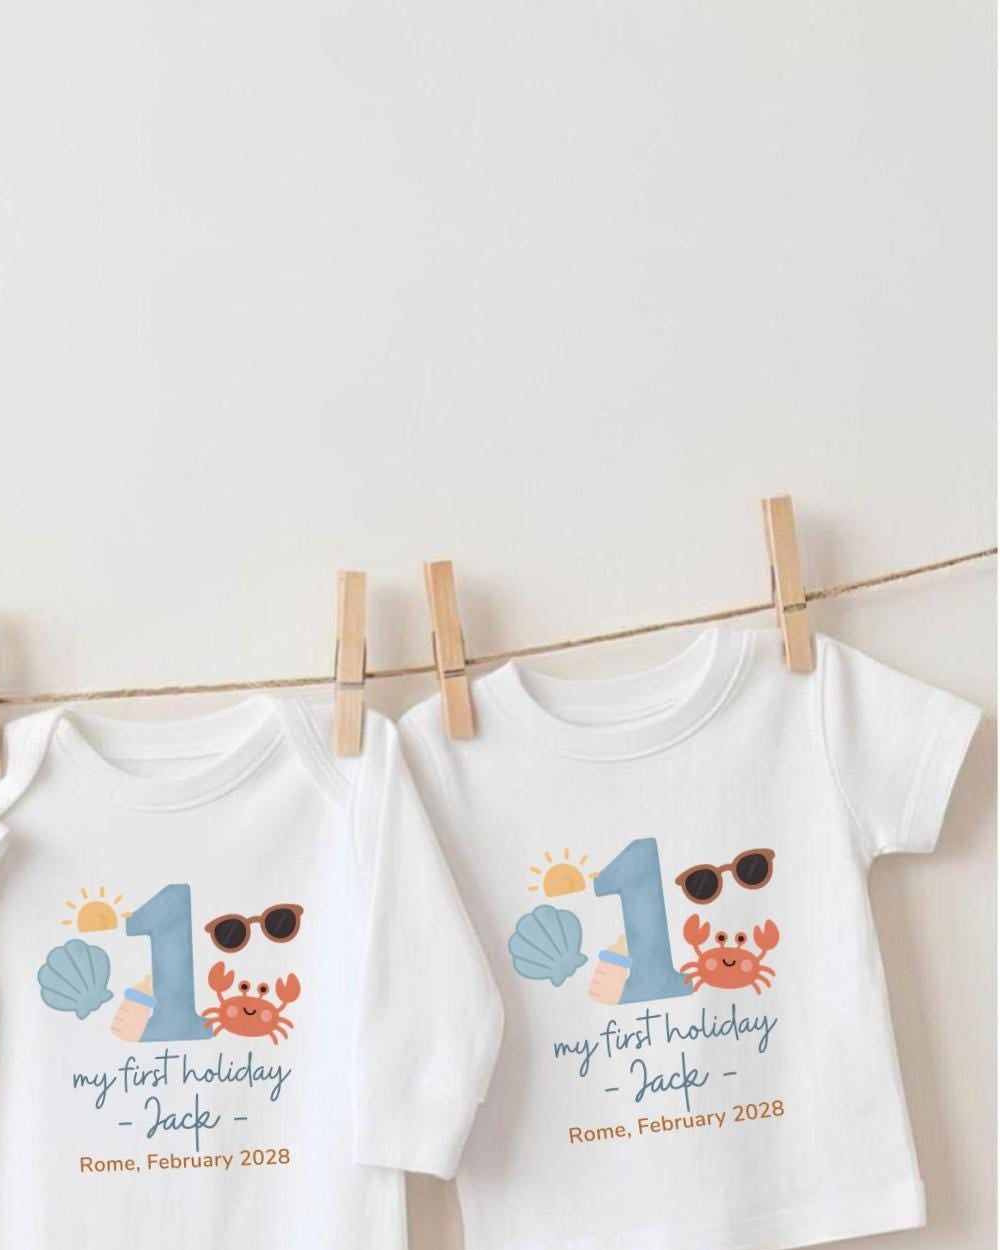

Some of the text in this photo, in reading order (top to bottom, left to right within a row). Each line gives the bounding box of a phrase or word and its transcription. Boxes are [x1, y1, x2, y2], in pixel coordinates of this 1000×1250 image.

[593, 837, 694, 1005] 1
[125, 883, 214, 1043] 1
[553, 1003, 778, 1077] my first holiday
[73, 1048, 292, 1110] my first holiday
[630, 1052, 709, 1112] Jack
[144, 1093, 221, 1152] Jack
[569, 1100, 785, 1144] Rome, February 2028
[80, 1149, 290, 1173] Rome, February 2028
